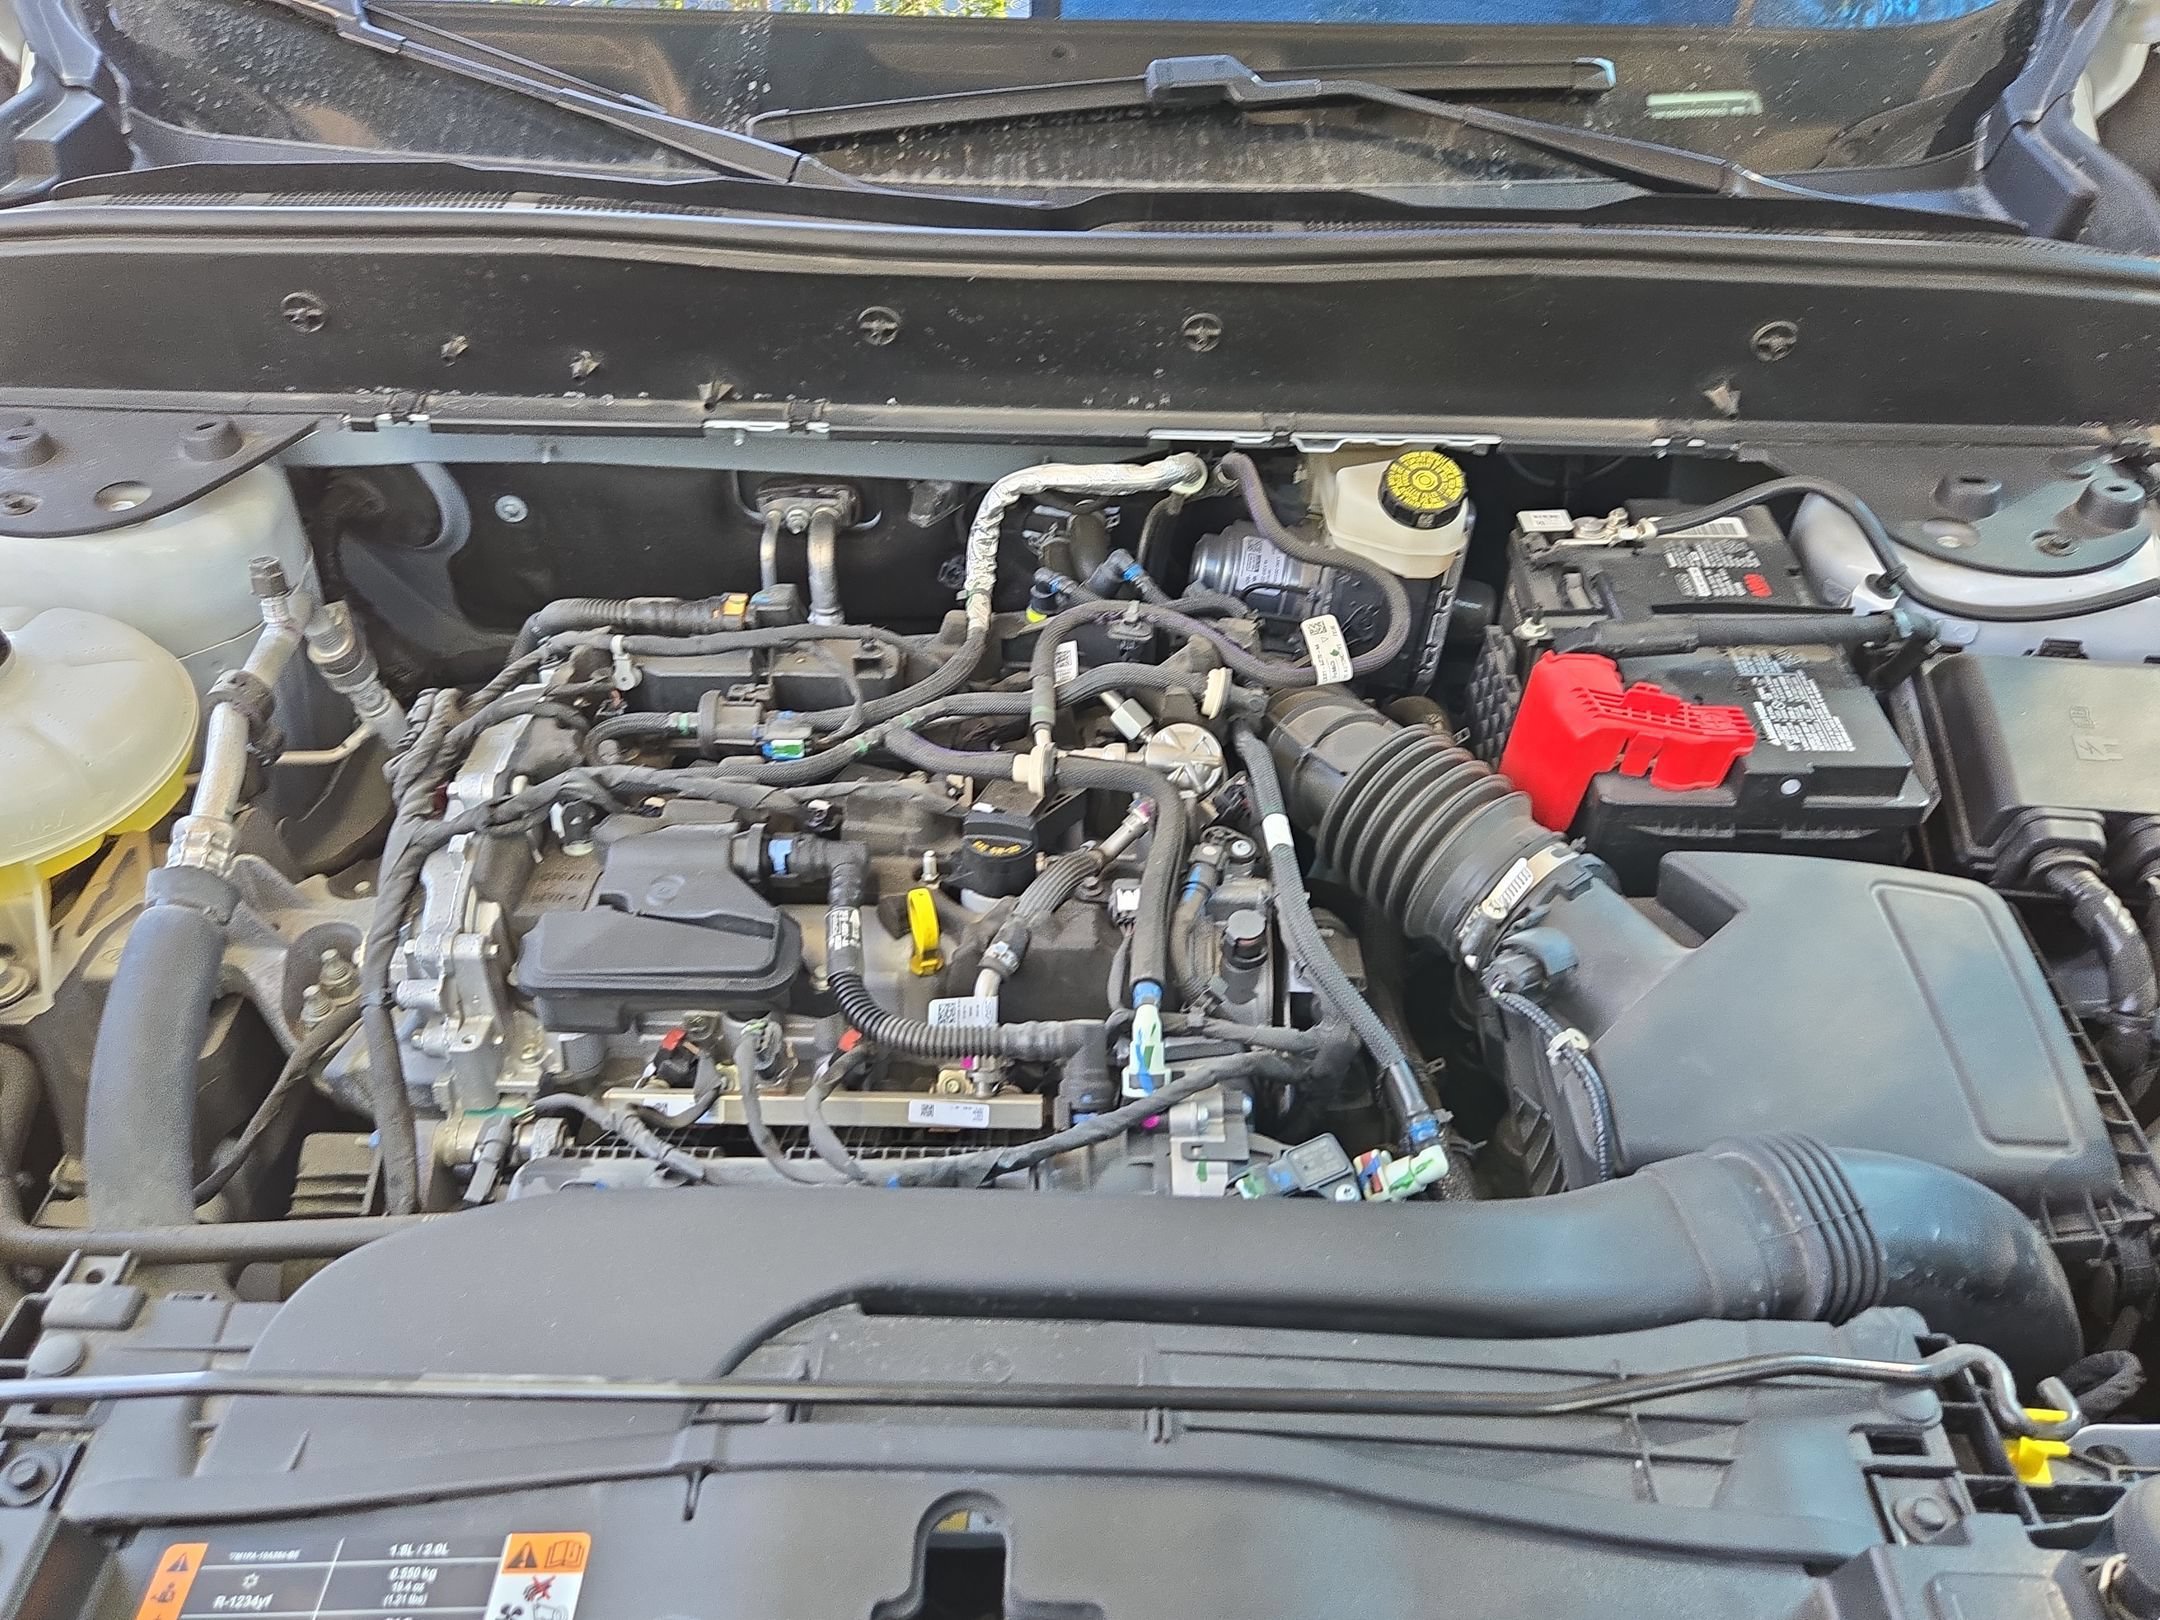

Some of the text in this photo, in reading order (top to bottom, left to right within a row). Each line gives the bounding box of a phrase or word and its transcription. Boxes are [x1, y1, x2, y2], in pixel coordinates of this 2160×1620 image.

[422, 1542, 450, 1557] 2.0L
[421, 1566, 438, 1583] kg
[213, 1593, 274, 1610] R-1234yf
